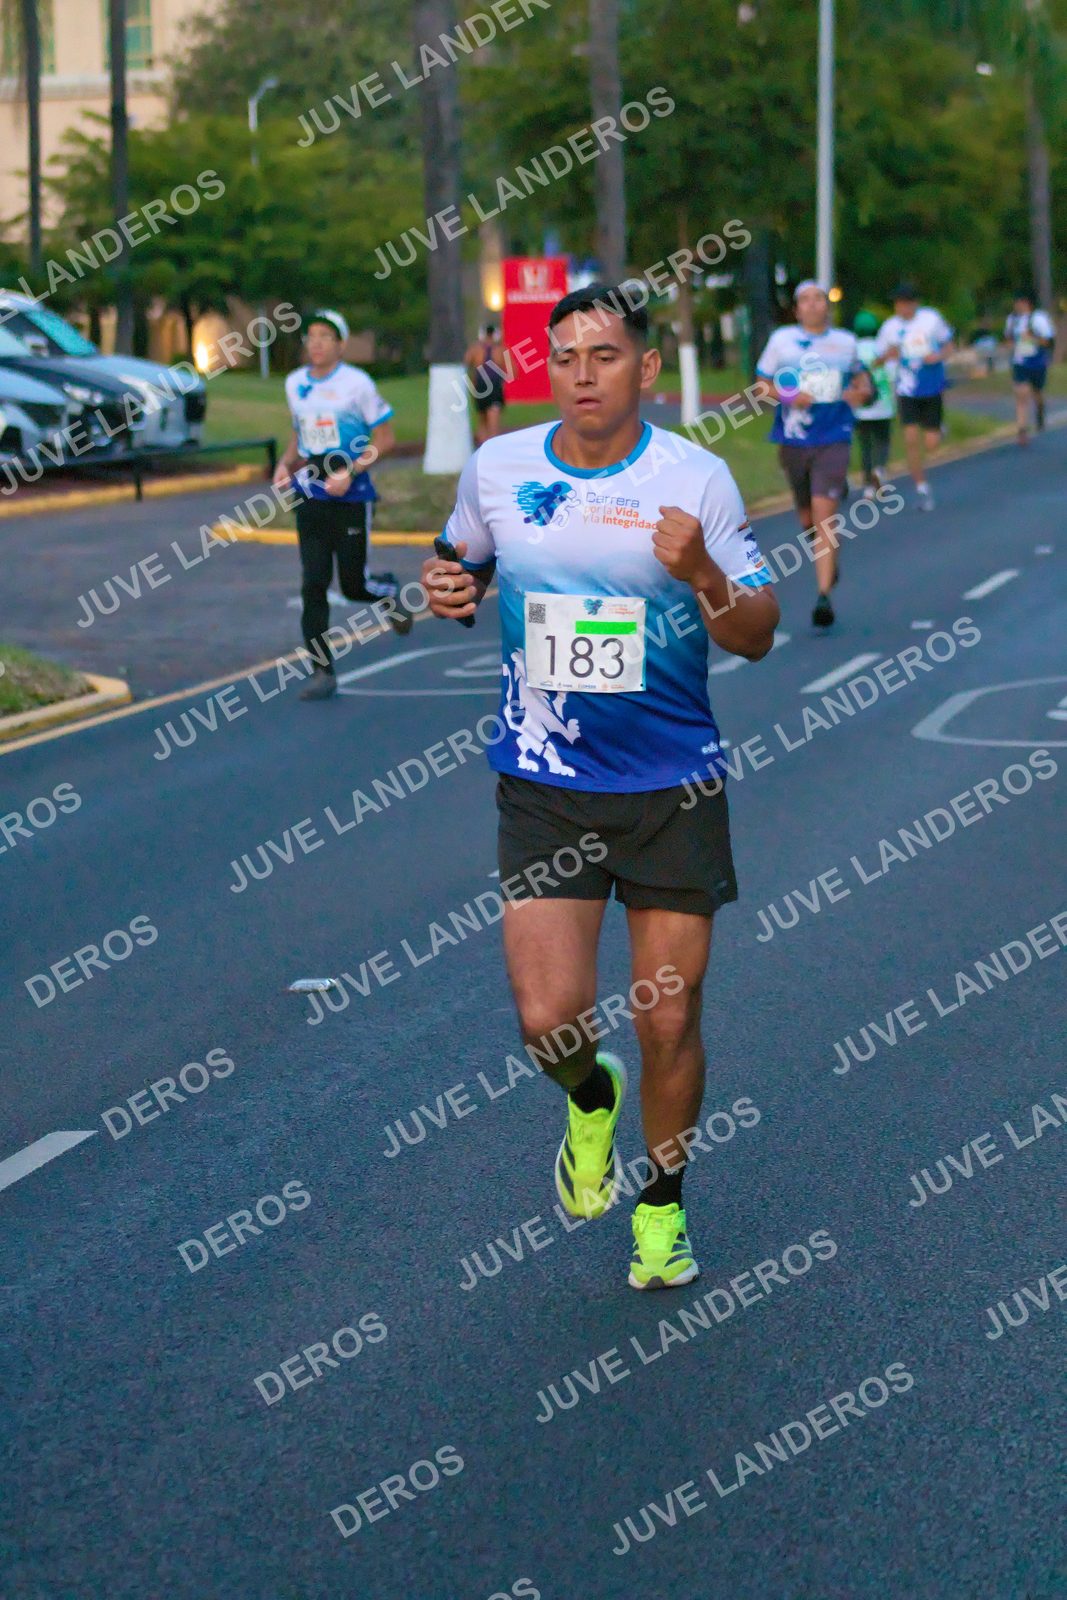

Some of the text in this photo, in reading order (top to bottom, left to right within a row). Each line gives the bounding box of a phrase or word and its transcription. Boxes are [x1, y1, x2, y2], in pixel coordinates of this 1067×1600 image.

[586, 492, 640, 508] Carrera
[615, 507, 639, 518] Vida
[545, 635, 624, 679] 183
